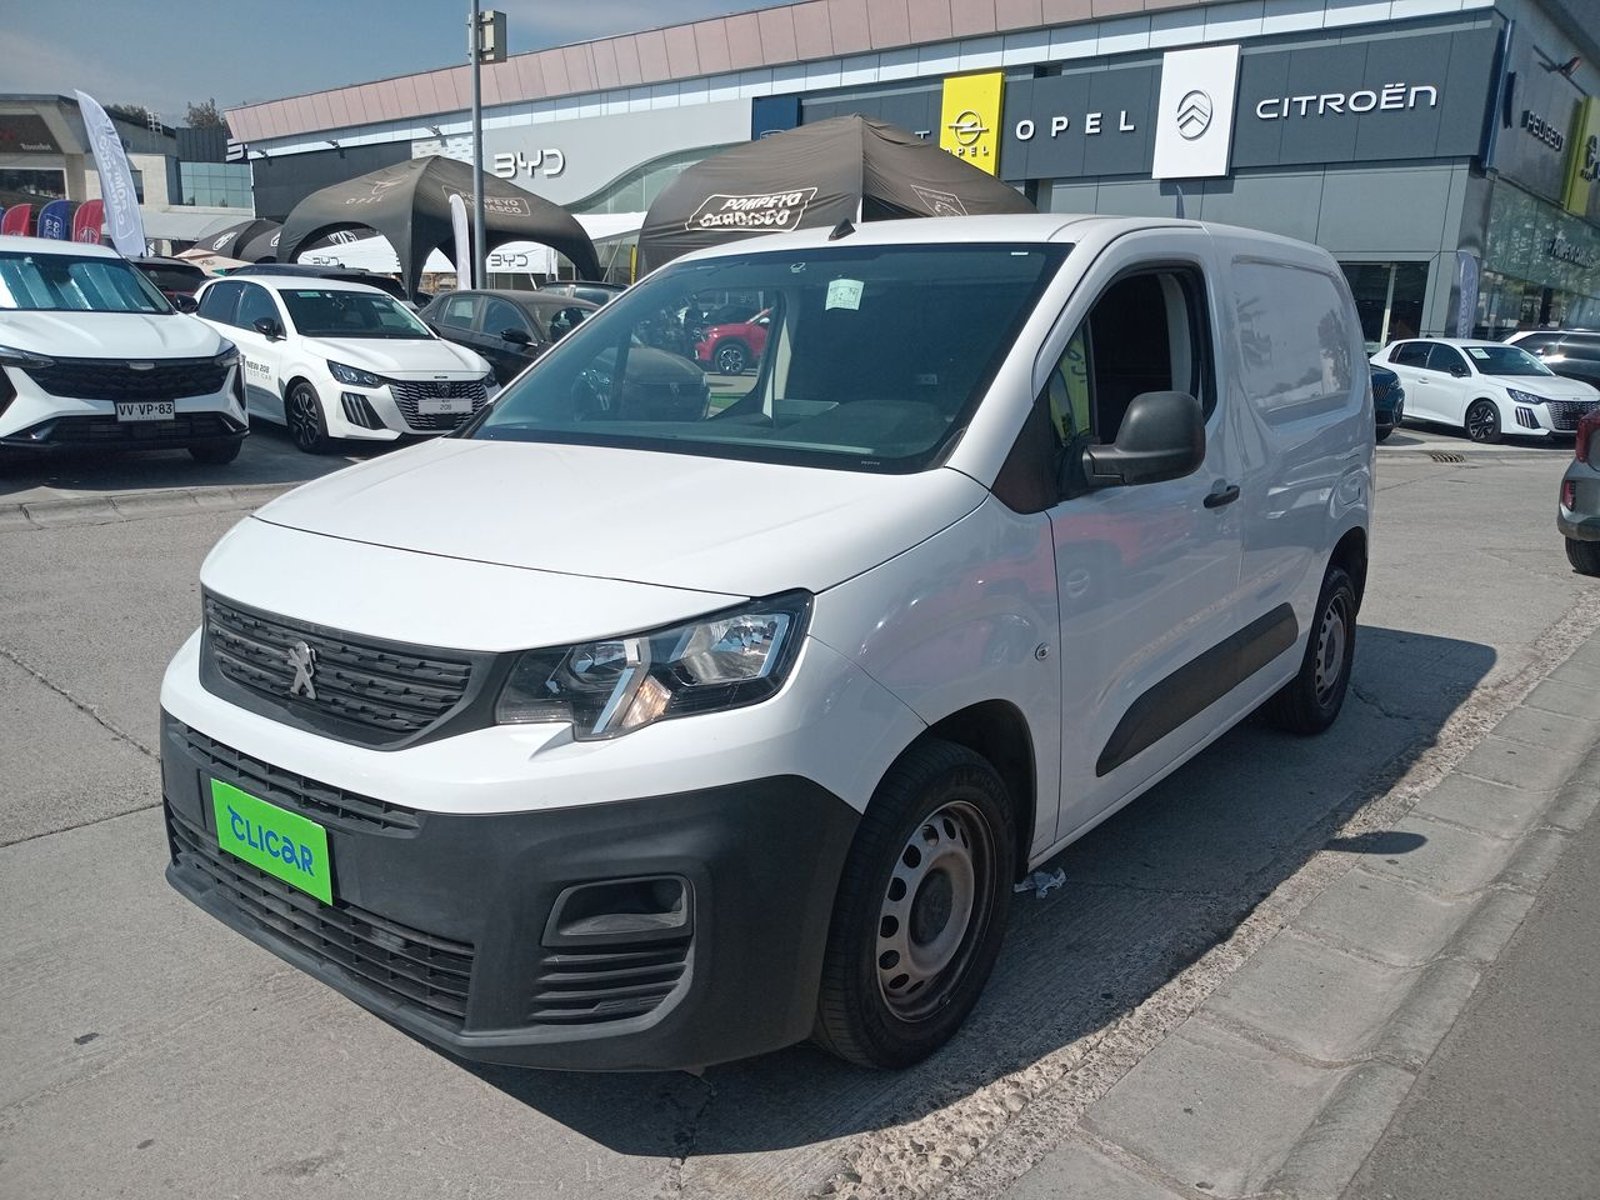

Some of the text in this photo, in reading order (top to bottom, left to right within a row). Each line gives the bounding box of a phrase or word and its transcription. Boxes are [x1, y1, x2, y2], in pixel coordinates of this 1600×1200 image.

[1255, 82, 1439, 121] CITROËN
[1015, 110, 1136, 141] OPEL
[494, 148, 566, 179] BYD
[460, 191, 519, 206] POPEYO
[720, 192, 803, 211] POMPEYO
[490, 253, 529, 267] BYD
